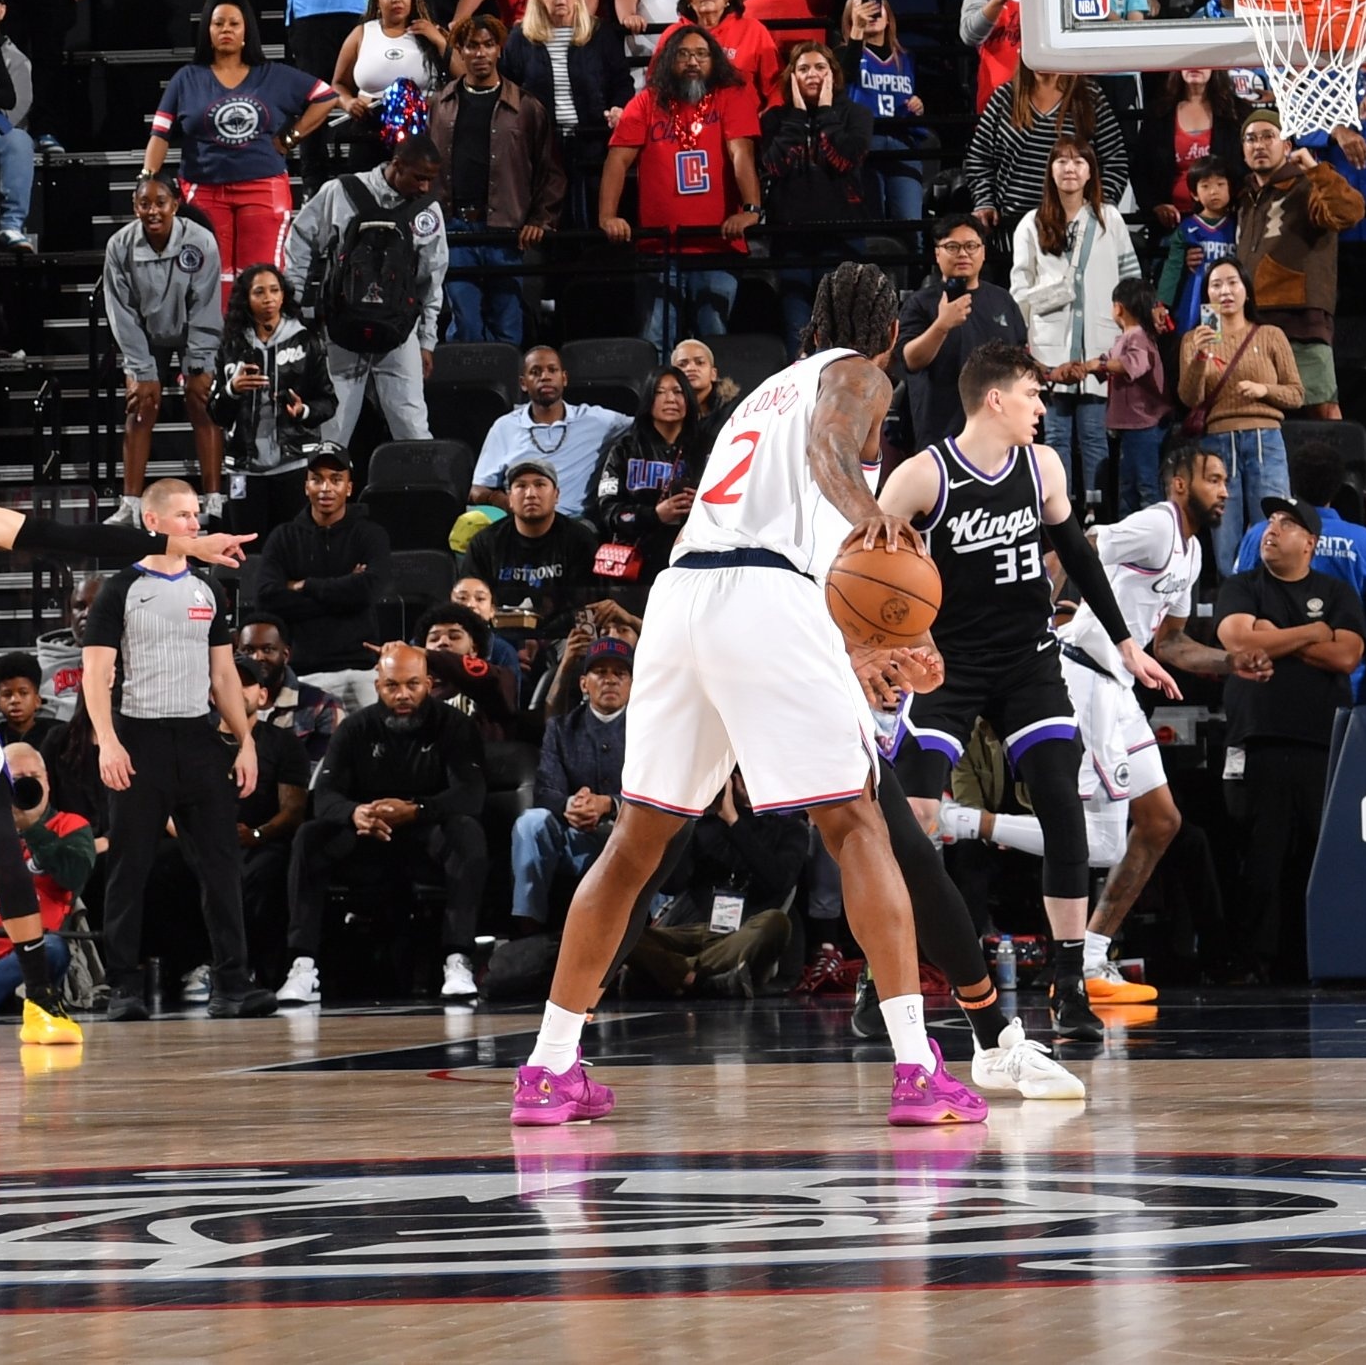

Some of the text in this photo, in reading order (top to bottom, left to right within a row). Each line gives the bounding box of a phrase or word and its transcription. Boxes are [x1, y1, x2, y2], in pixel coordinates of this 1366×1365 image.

[1077, 0, 1097, 14] NBA
[860, 72, 913, 96] CLIPPERS
[877, 94, 897, 118] 13
[628, 458, 674, 492] CLIPP
[701, 431, 761, 505] 2
[945, 505, 1036, 556] Kings
[1317, 536, 1354, 550] RITY
[993, 548, 1039, 584] 33
